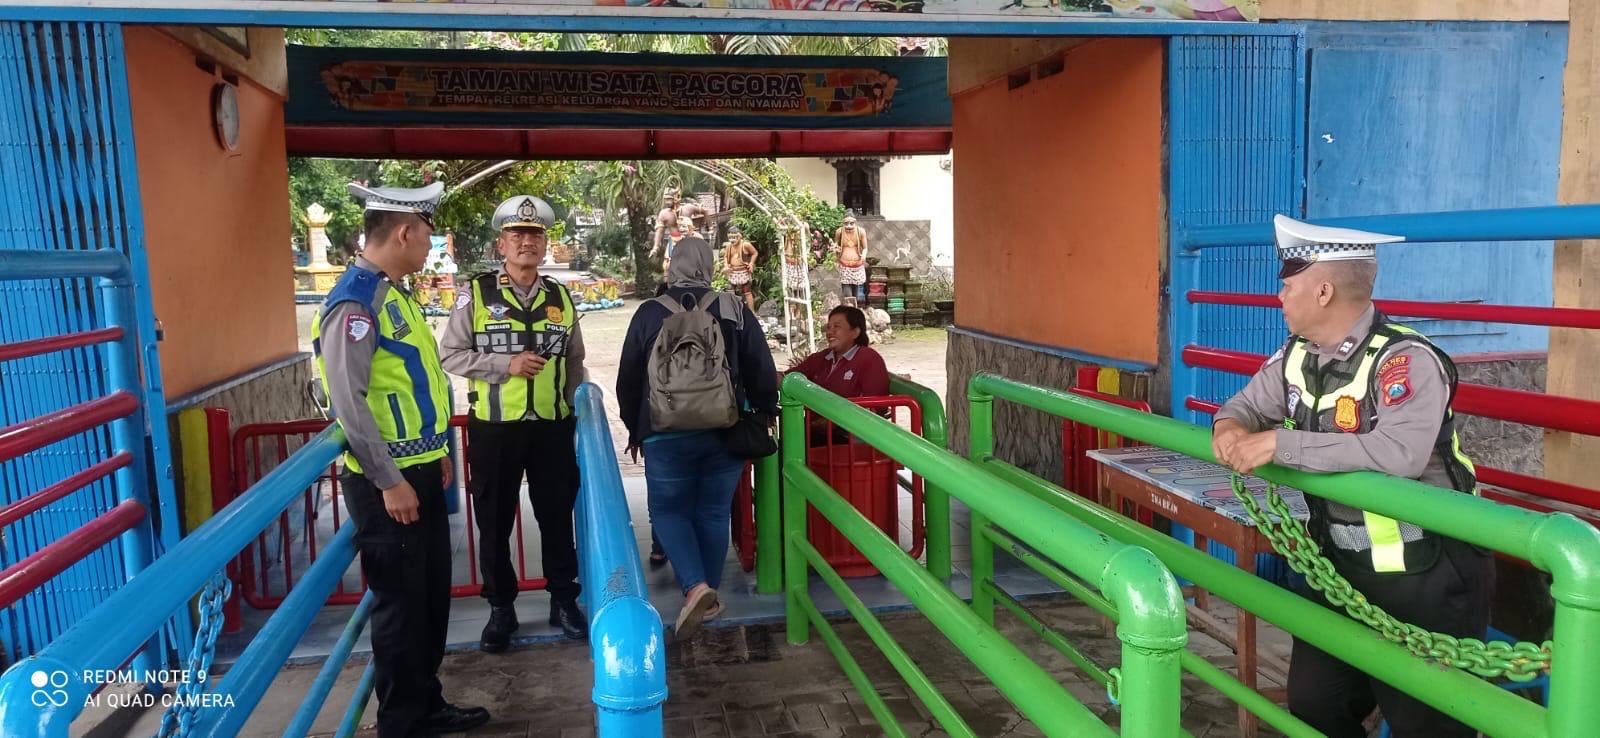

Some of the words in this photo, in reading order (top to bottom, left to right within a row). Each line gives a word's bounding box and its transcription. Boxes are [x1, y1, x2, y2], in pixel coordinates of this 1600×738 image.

[431, 69, 542, 93] TAMAN
[550, 71, 662, 95] WISATA
[668, 73, 804, 97] PAGGORA
[438, 94, 489, 105] TEMPAT
[494, 95, 558, 106] REKREASI
[562, 95, 630, 107] KELUARGA
[634, 96, 668, 107] YANG
[672, 97, 712, 107] SEHAT
[716, 97, 742, 108] DAN
[746, 98, 800, 109] NYAMAN
